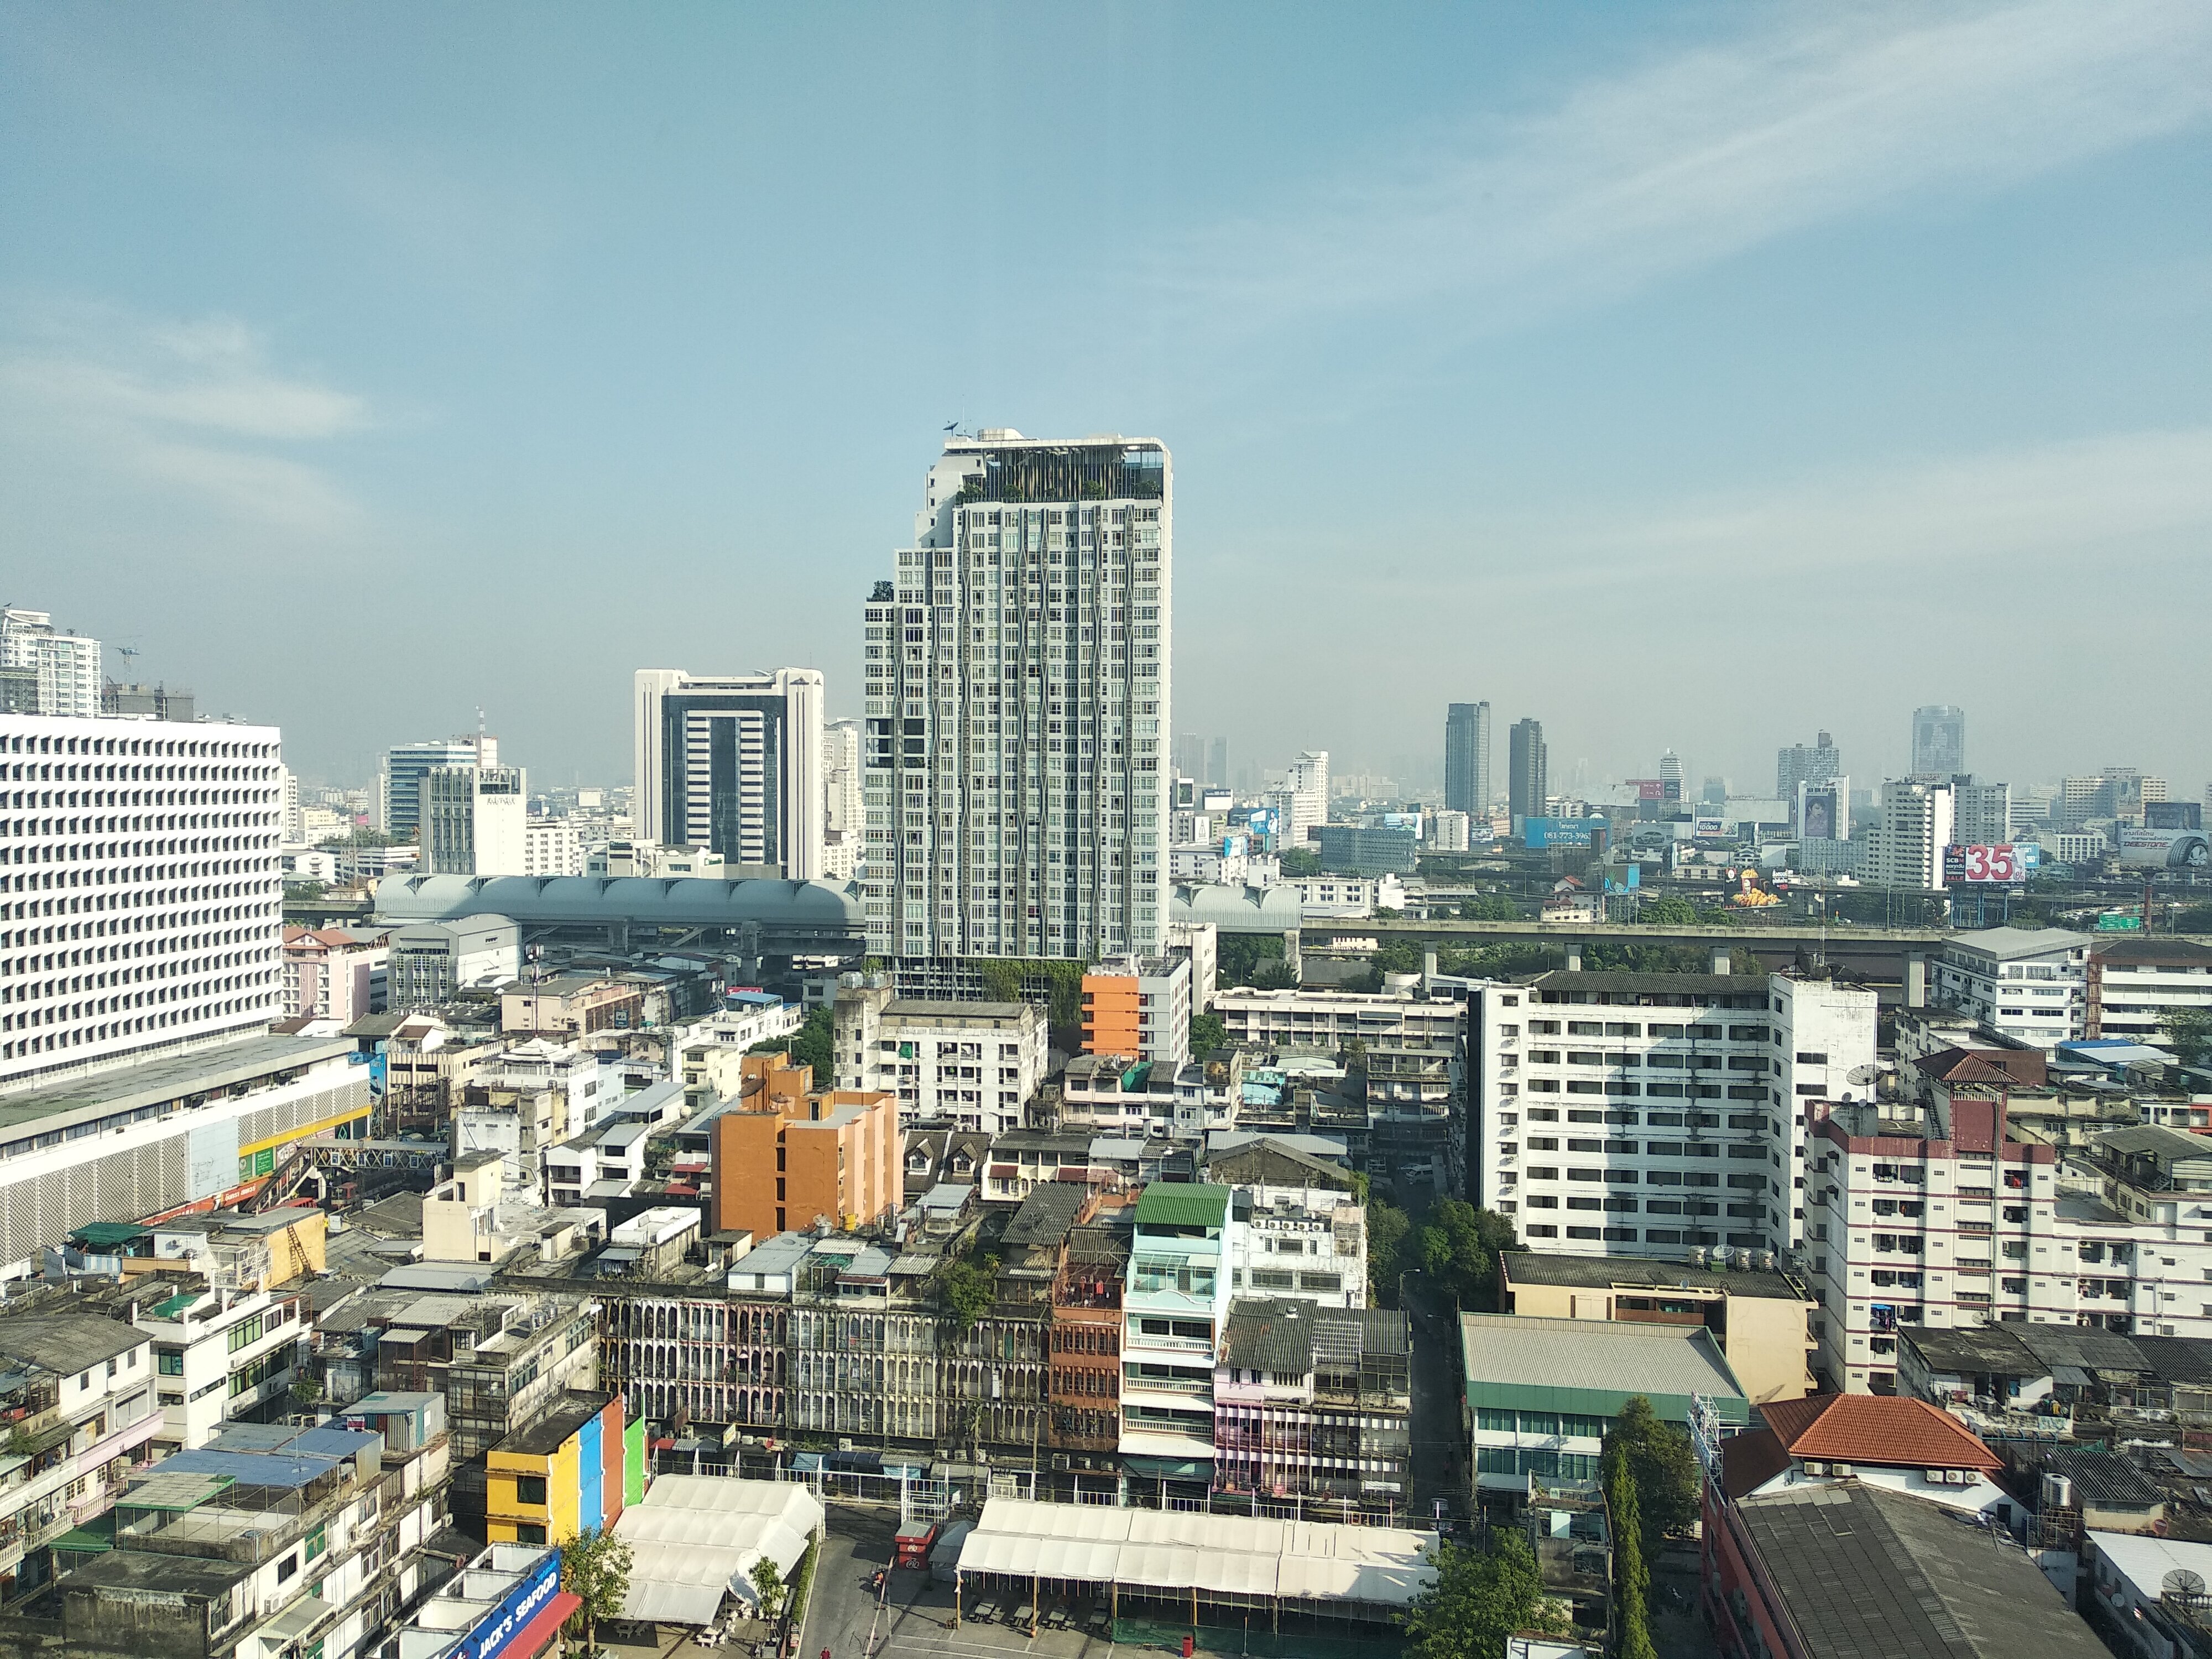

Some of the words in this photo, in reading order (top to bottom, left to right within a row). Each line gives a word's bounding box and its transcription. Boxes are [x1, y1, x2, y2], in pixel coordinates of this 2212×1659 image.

[1966, 844, 2013, 880] 35
[478, 1615, 512, 1659] JACK'S
[515, 1572, 557, 1623] SEAFOOD
